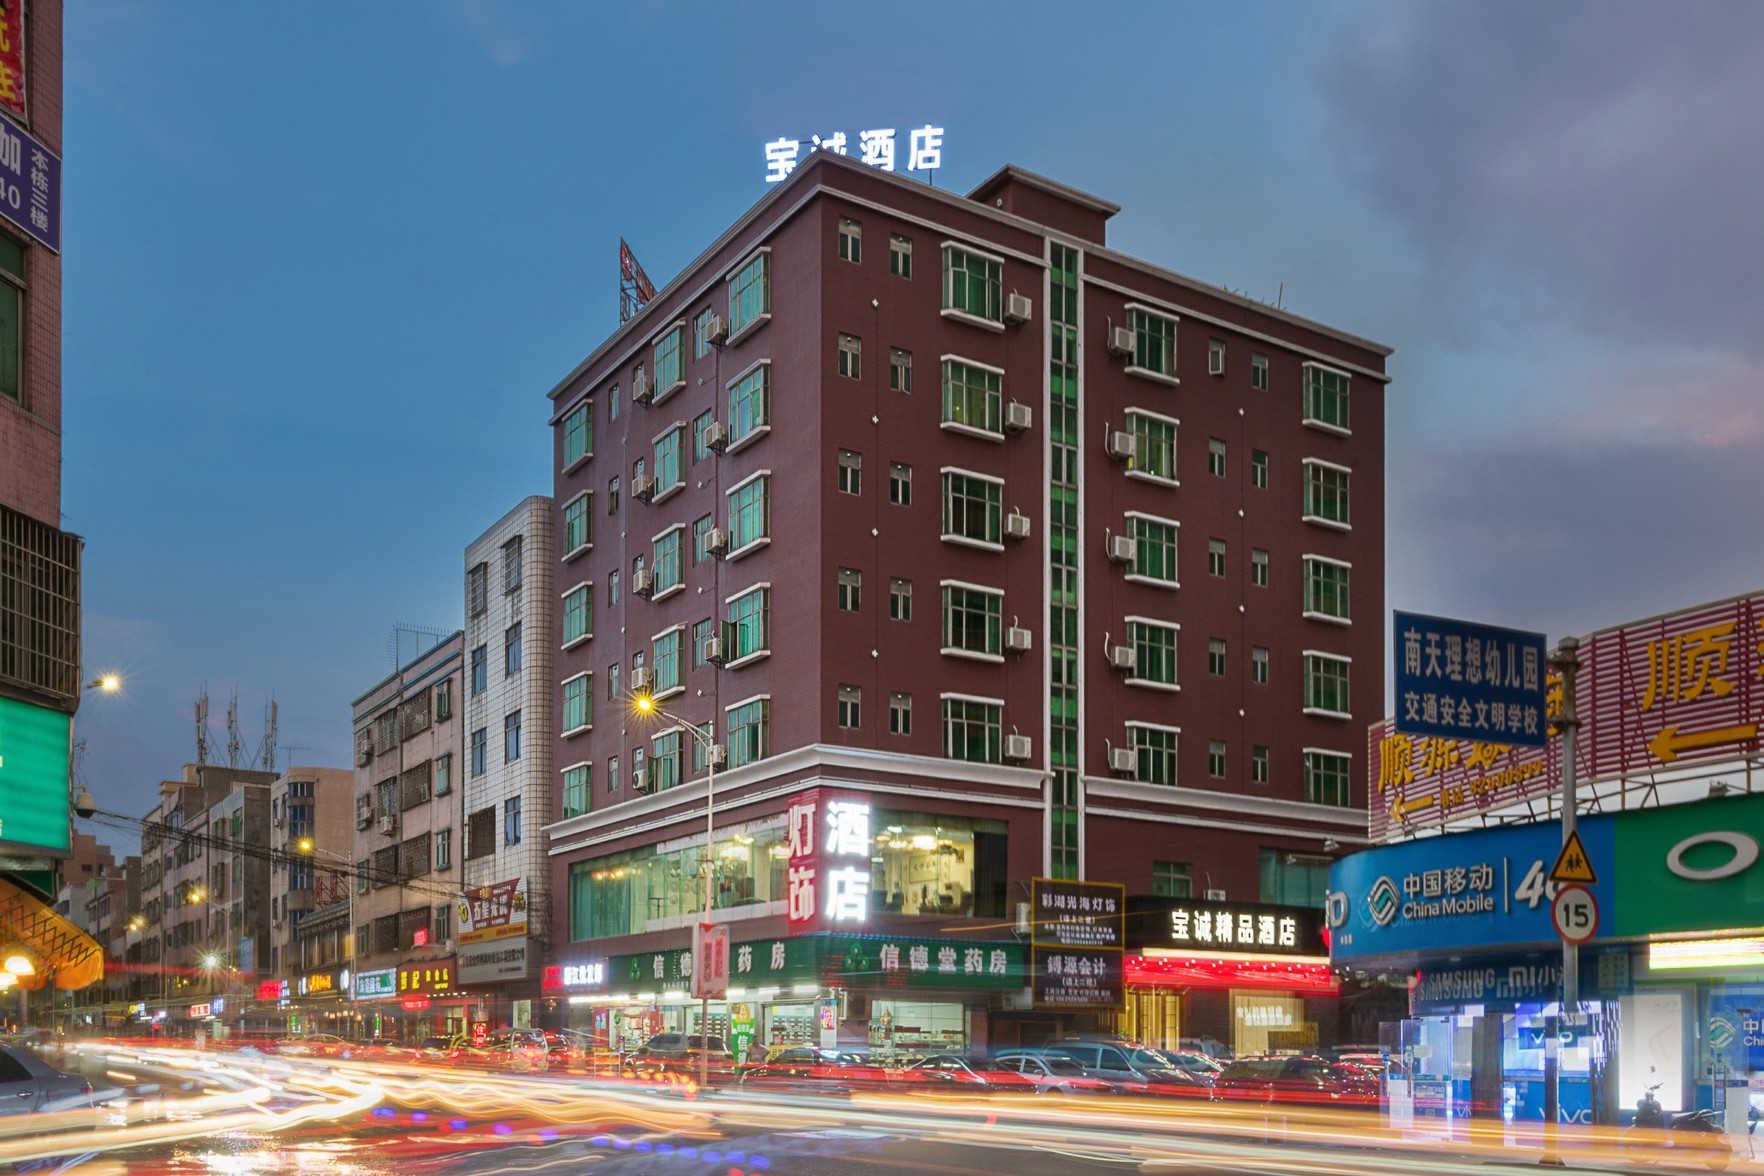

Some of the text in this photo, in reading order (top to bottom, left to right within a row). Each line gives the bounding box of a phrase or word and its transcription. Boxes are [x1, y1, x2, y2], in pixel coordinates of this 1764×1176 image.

[30, 148, 49, 233] 本栋三楼
[1404, 626, 1538, 692] 南天理想幼儿园
[1642, 617, 1764, 712] 顺
[1404, 690, 1538, 735] 交通安全文明学校
[788, 803, 816, 921] 灯饰
[826, 801, 870, 922] 酒店
[1403, 863, 1494, 899] 中国移动
[1402, 894, 1495, 920] China Mobile
[1563, 903, 1589, 928] 15
[1171, 908, 1296, 946] 宝诚精品酒店
[653, 941, 786, 980] 信德药房
[879, 943, 1008, 975] 信德堂药房
[1427, 968, 1496, 996] SAMSUNG
[1743, 1018, 1764, 1035] 中
